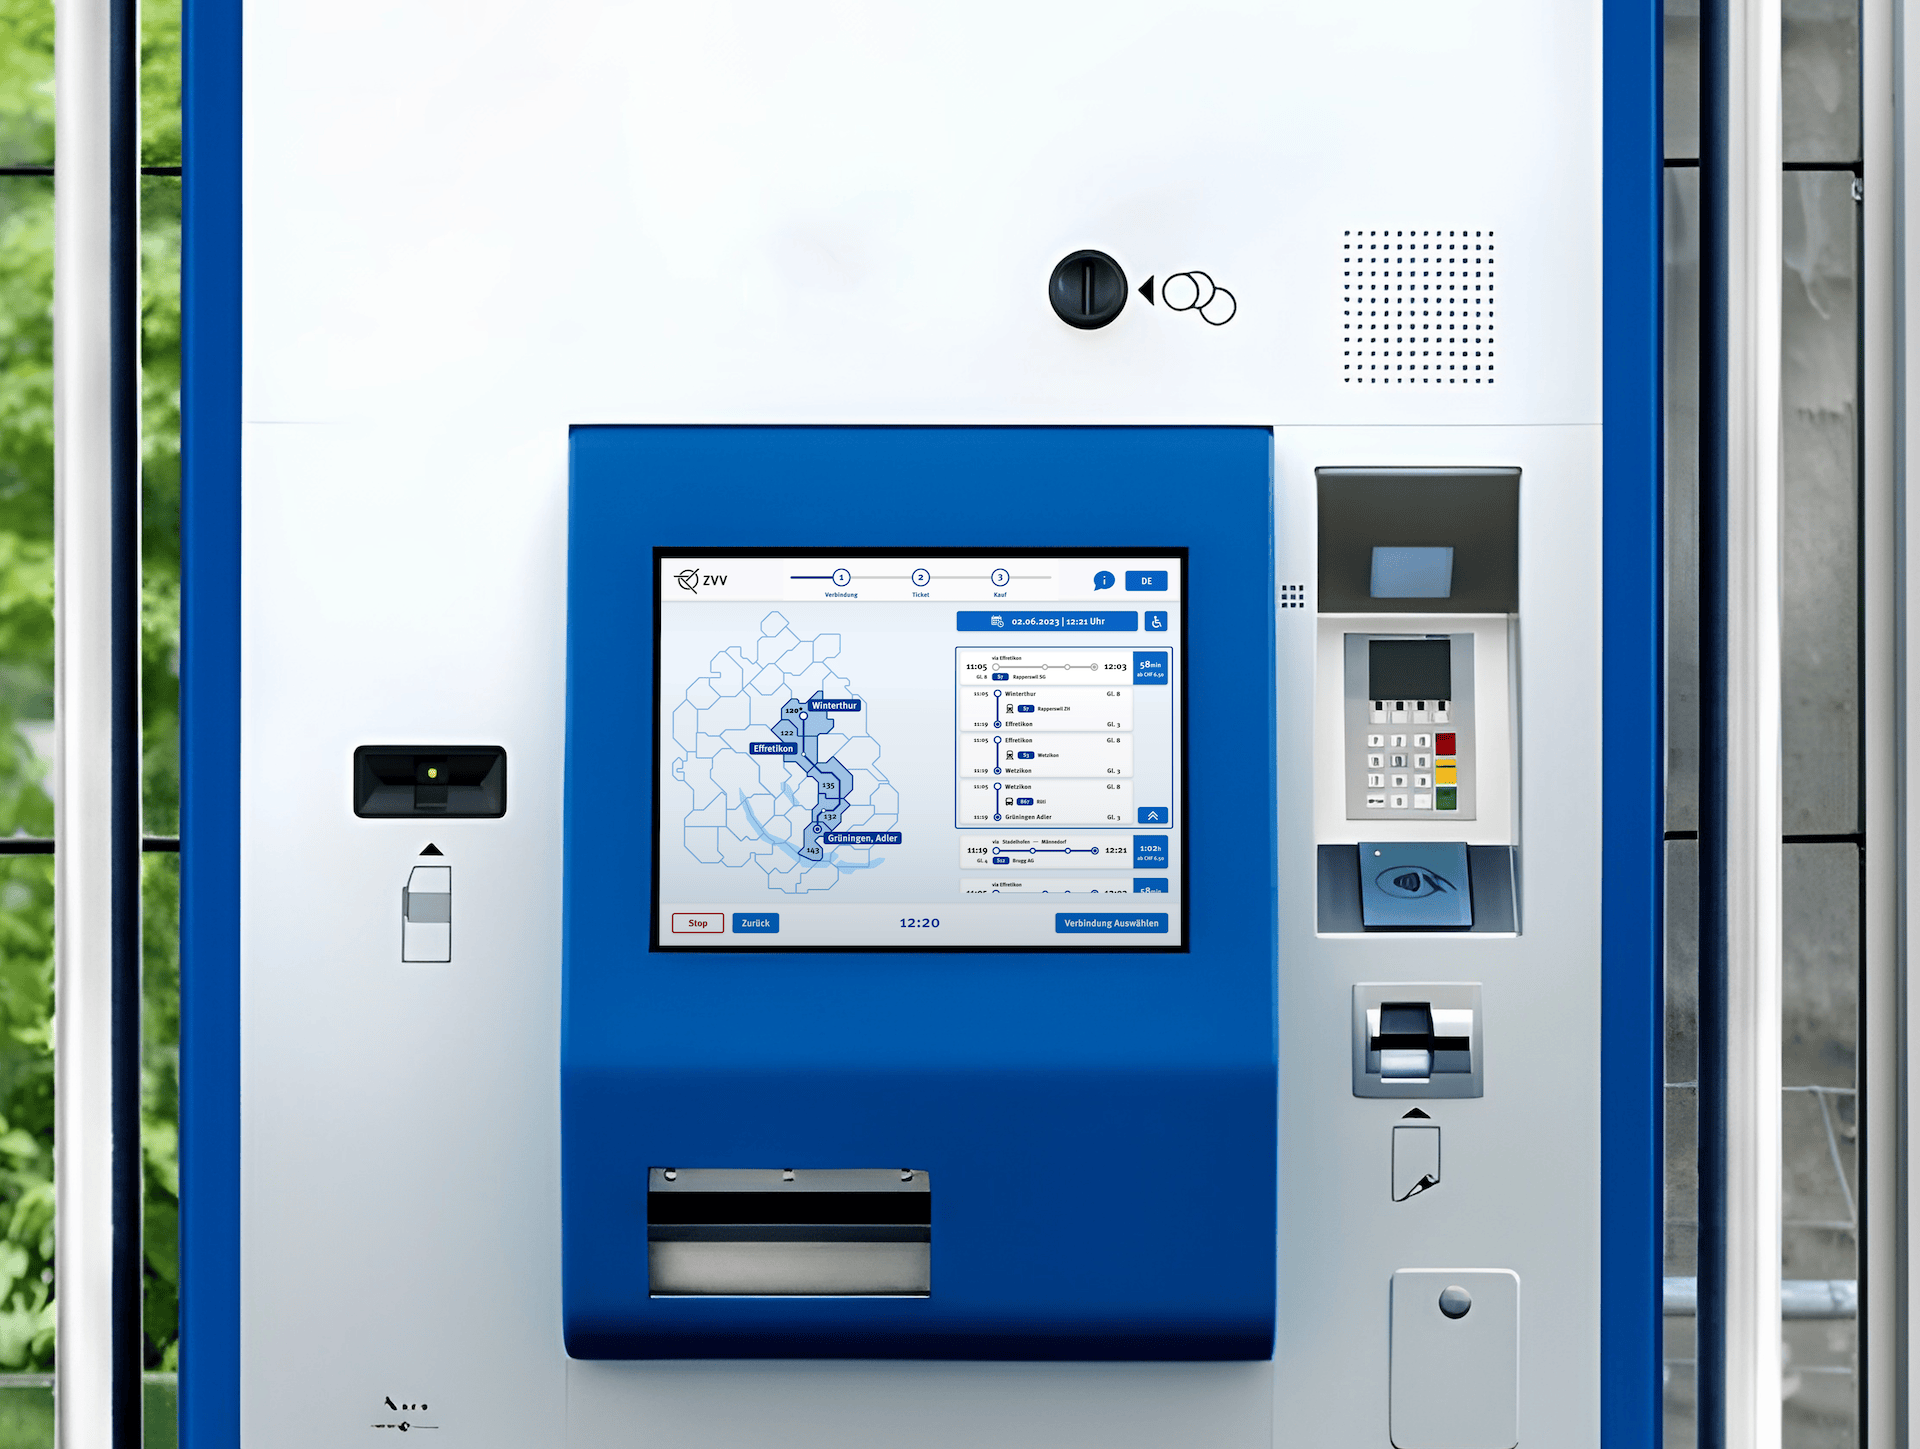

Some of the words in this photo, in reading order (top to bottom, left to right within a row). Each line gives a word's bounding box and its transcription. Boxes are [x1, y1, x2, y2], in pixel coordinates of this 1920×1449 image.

[703, 575, 728, 586] ZVV
[1141, 577, 1152, 585] DE
[1012, 618, 1059, 627] 02.06.2023
[1090, 617, 1105, 625] Uhr
[812, 701, 857, 710] Winterthur
[754, 744, 794, 753] Effretikon
[828, 833, 873, 843] Grüningen,
[875, 834, 898, 842] Adler
[689, 919, 708, 928] Stop
[742, 919, 770, 928] Zurück
[900, 918, 940, 927] 12:20
[1065, 919, 1112, 928] Verbindung
[1114, 919, 1159, 927] Auswählen
